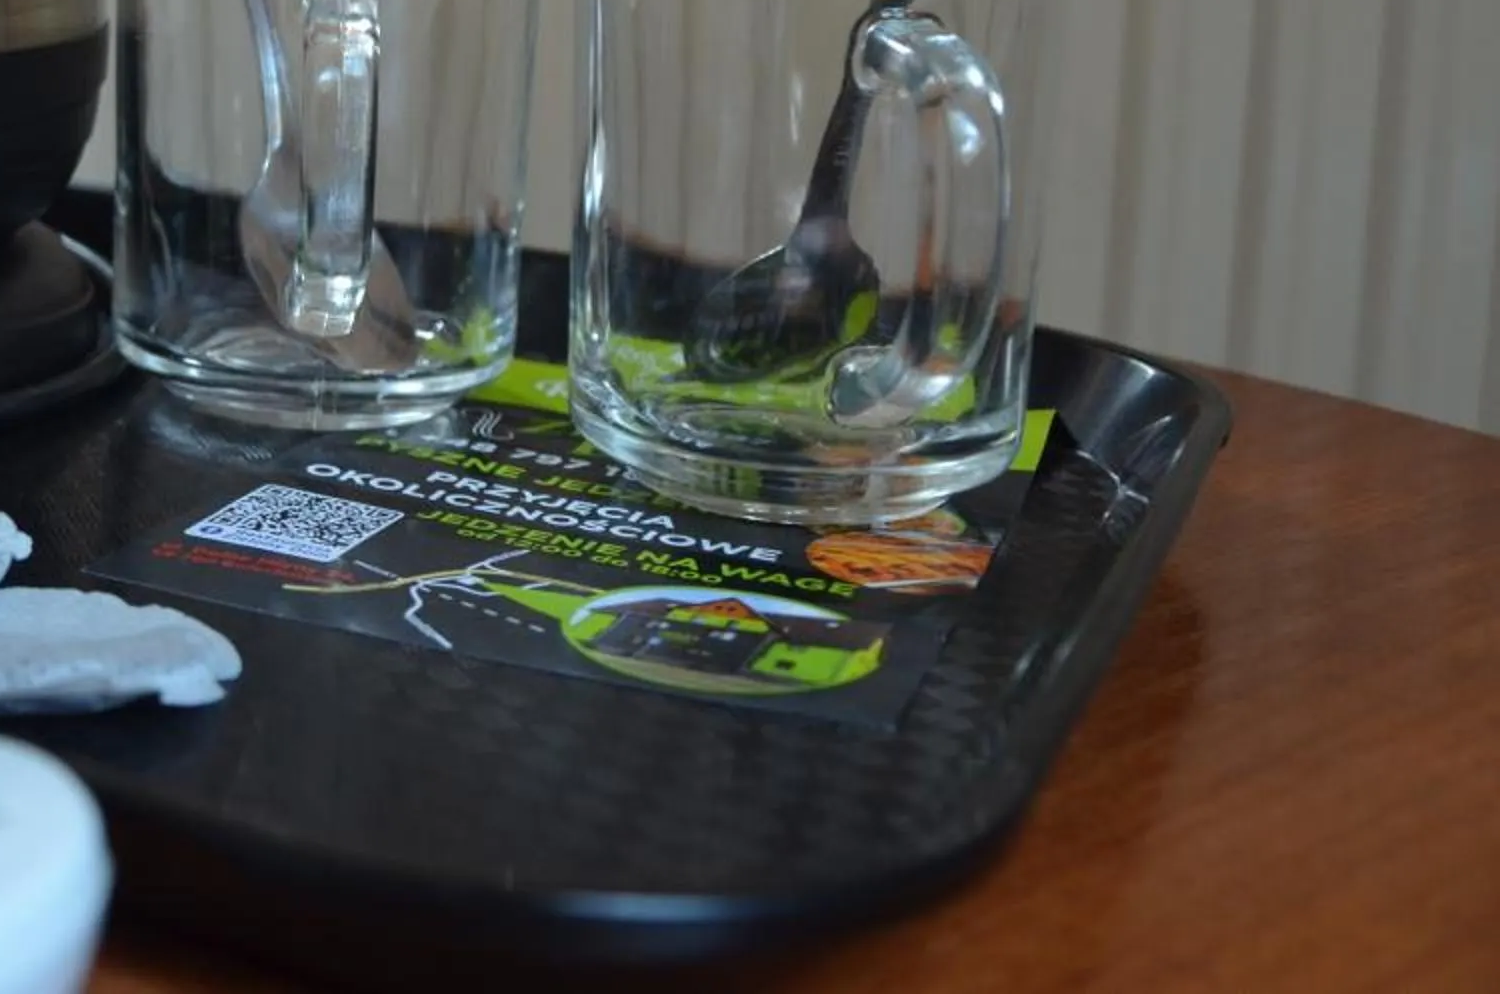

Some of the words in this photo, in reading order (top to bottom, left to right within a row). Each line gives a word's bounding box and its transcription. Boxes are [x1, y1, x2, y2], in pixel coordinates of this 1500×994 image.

[306, 463, 783, 563] OKOLICZNOŚCIOWE
[426, 471, 676, 528] PRZYJĘCIA
[416, 509, 628, 555] JEDZENIE
[636, 549, 699, 573] NA
[455, 528, 499, 541] od
[591, 555, 629, 568] do
